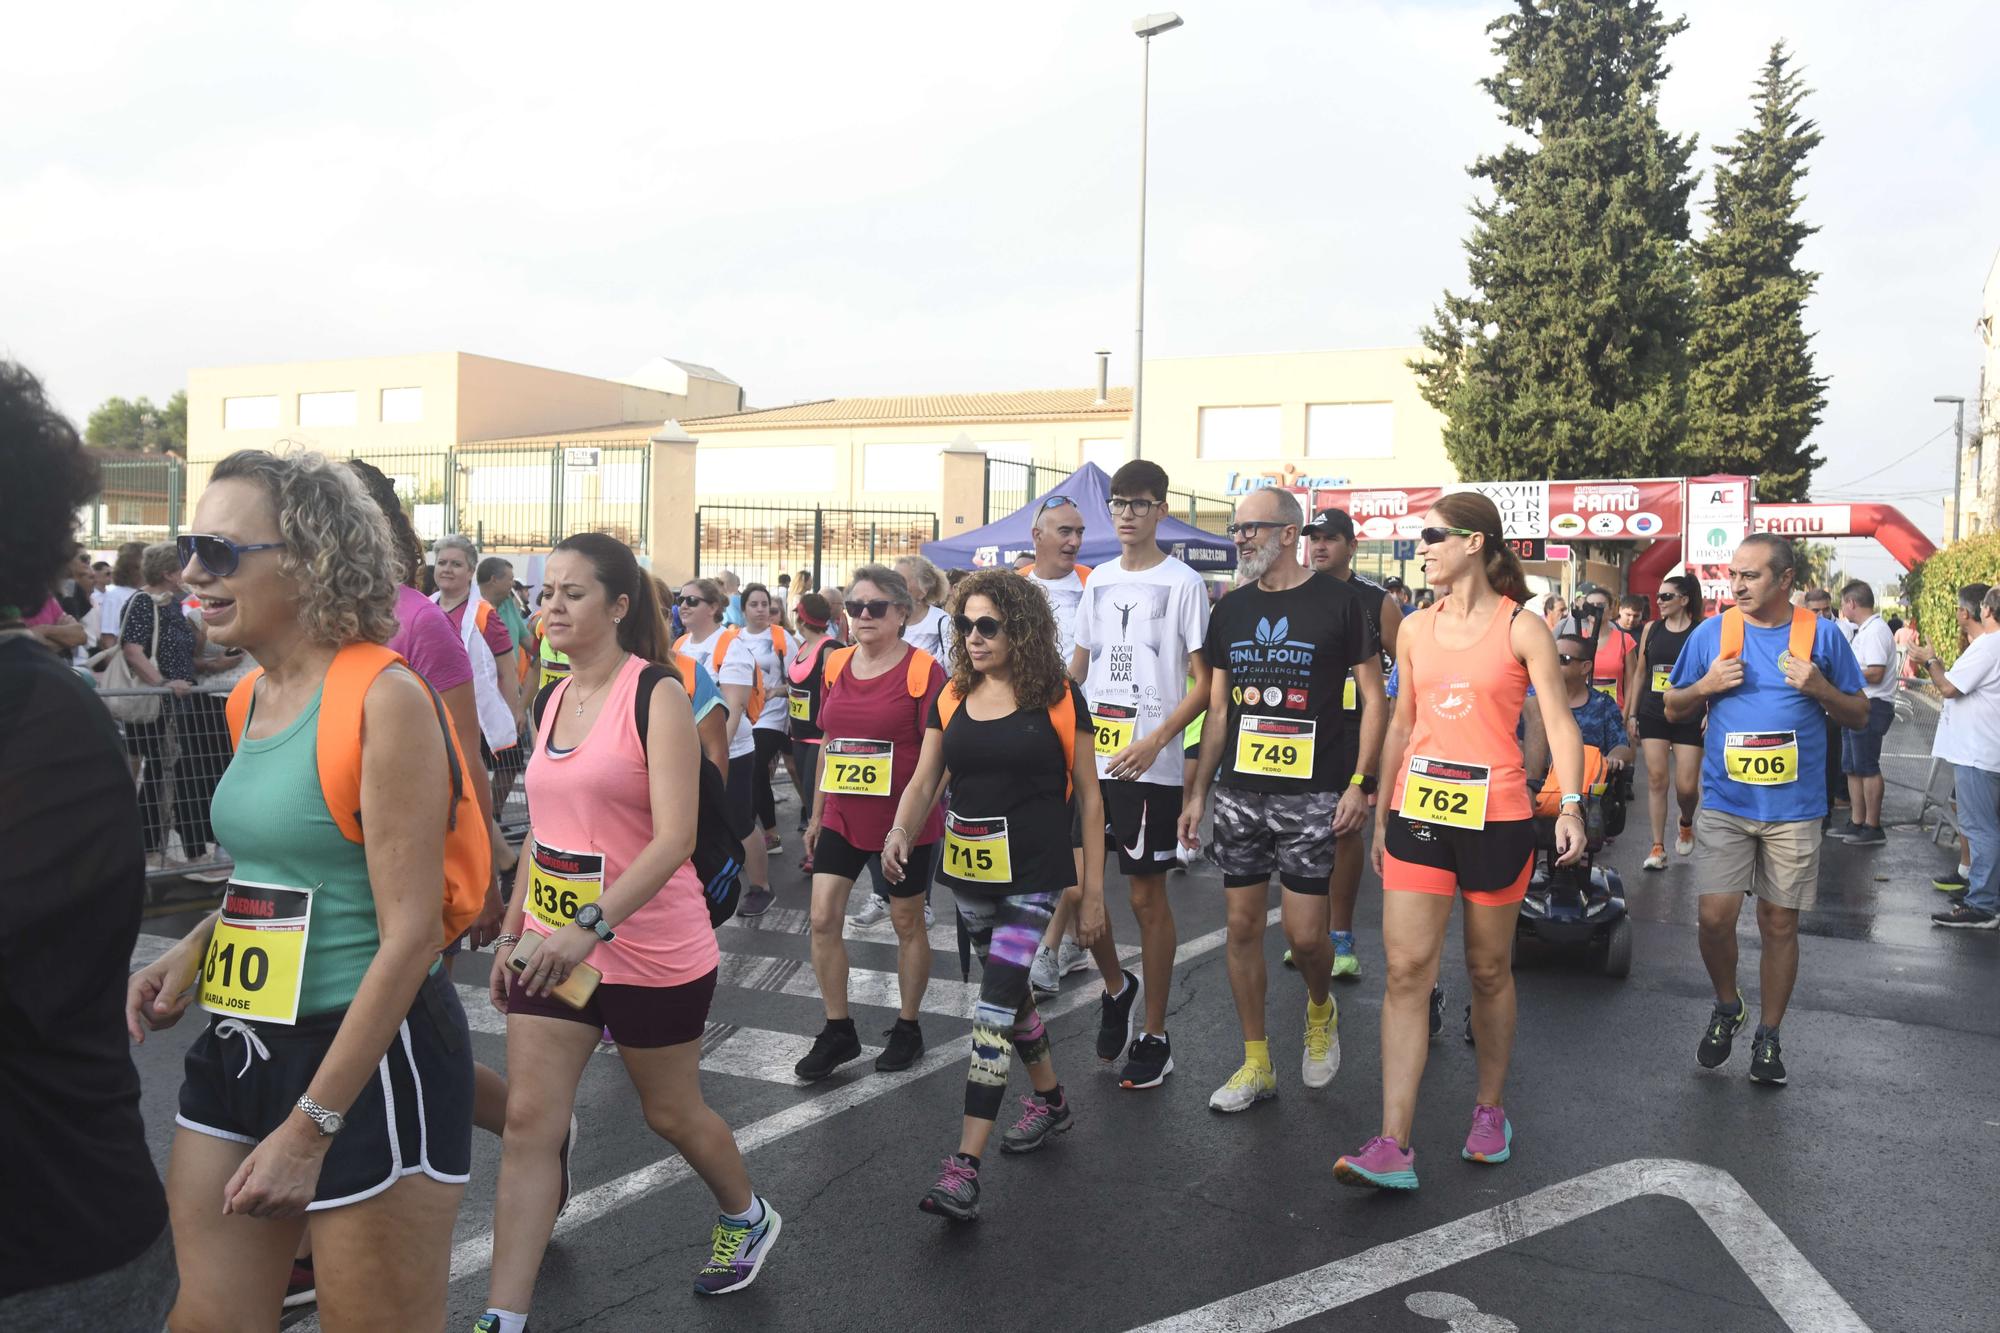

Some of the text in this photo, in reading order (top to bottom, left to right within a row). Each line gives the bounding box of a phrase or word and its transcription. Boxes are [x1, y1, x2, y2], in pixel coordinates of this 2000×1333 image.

[1500, 499, 1540, 511] ON
[1573, 493, 1639, 513] FAMU
[1504, 524, 1540, 535] AS
[1267, 649, 1313, 666] FOUR
[1250, 667, 1297, 676] CHALLENGE
[1251, 743, 1298, 766] 749
[836, 764, 877, 785] 726
[1738, 756, 1785, 775] 706
[1418, 786, 1469, 815] 762
[1431, 814, 1448, 822] RAFA
[950, 843, 993, 871] 715
[534, 878, 579, 919] 836
[206, 939, 269, 992] 810
[205, 992, 251, 1010] MARIA JOSE
